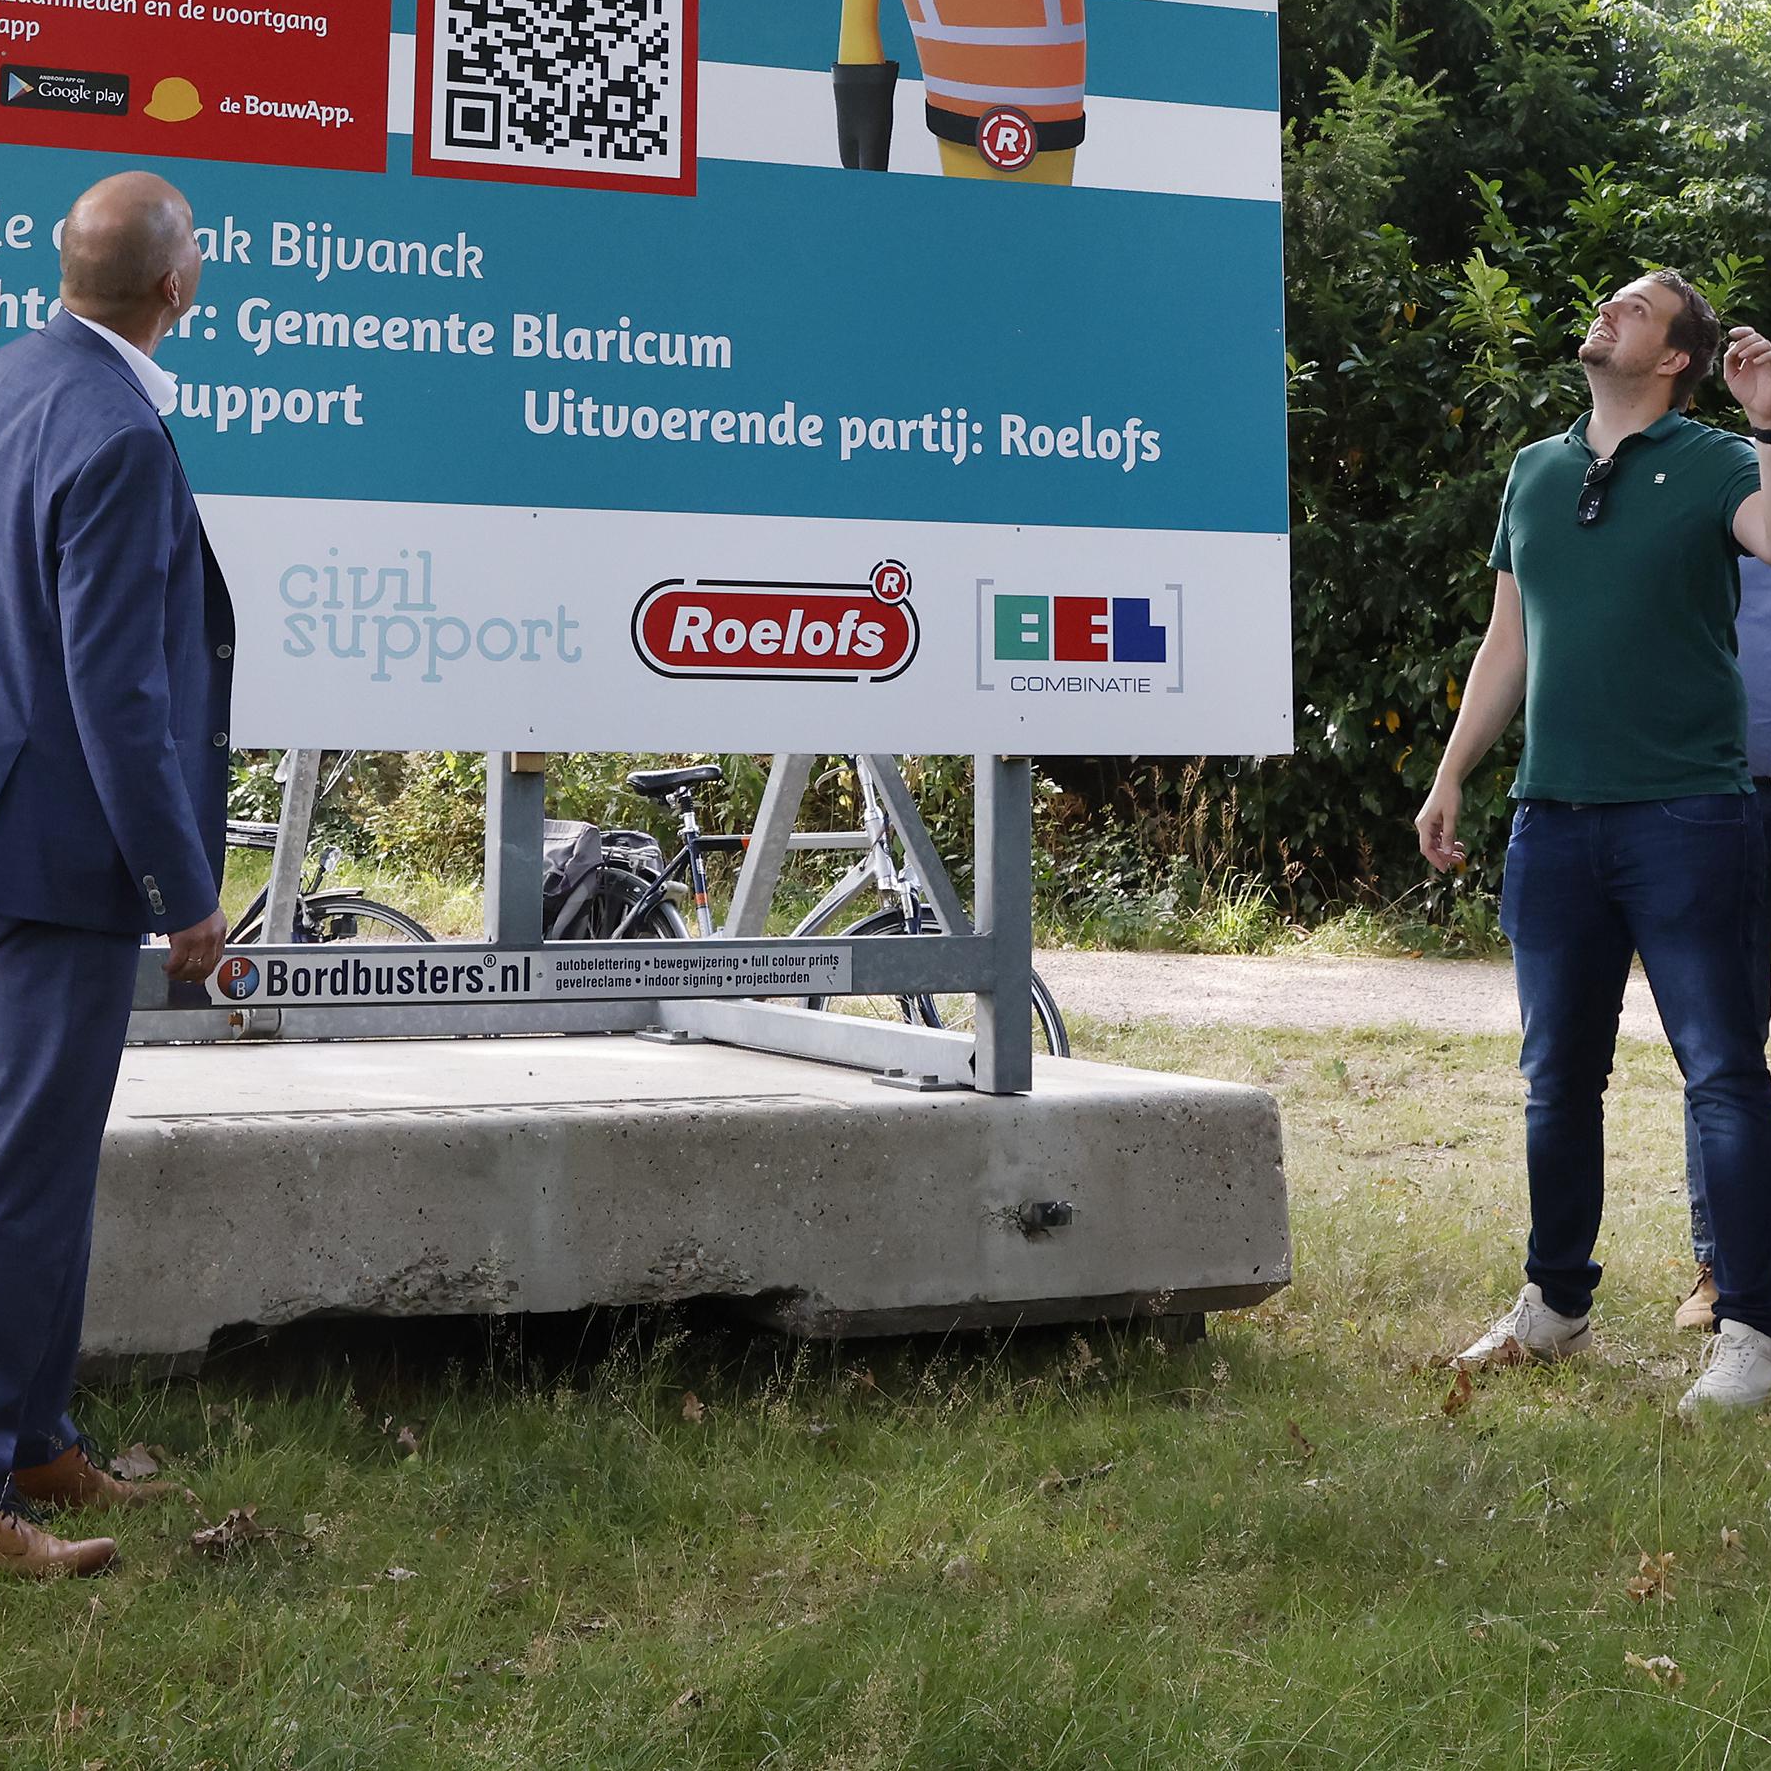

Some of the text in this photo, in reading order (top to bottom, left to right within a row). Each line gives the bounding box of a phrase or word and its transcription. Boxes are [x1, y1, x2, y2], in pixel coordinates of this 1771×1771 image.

[144, 0, 171, 17] en
[213, 7, 328, 37] voortgang
[38, 82, 125, 106] Google play
[39, 75, 65, 83] ANDROID
[220, 95, 355, 128] de BouwApp.
[995, 126, 1019, 153] R
[271, 221, 484, 283] Bijvanck
[236, 297, 496, 356] Gemeente
[512, 313, 732, 368] Blaricum
[523, 388, 1162, 473] Uitvoerende partij: Roelofs
[283, 604, 582, 683] support
[668, 606, 886, 657] Roelofs
[1010, 676, 1152, 693] COMBINATIE
[555, 954, 839, 972] autobelettering bewegwijzering full colour prints
[555, 972, 810, 990] gevelreclame indoor signing projectborden
